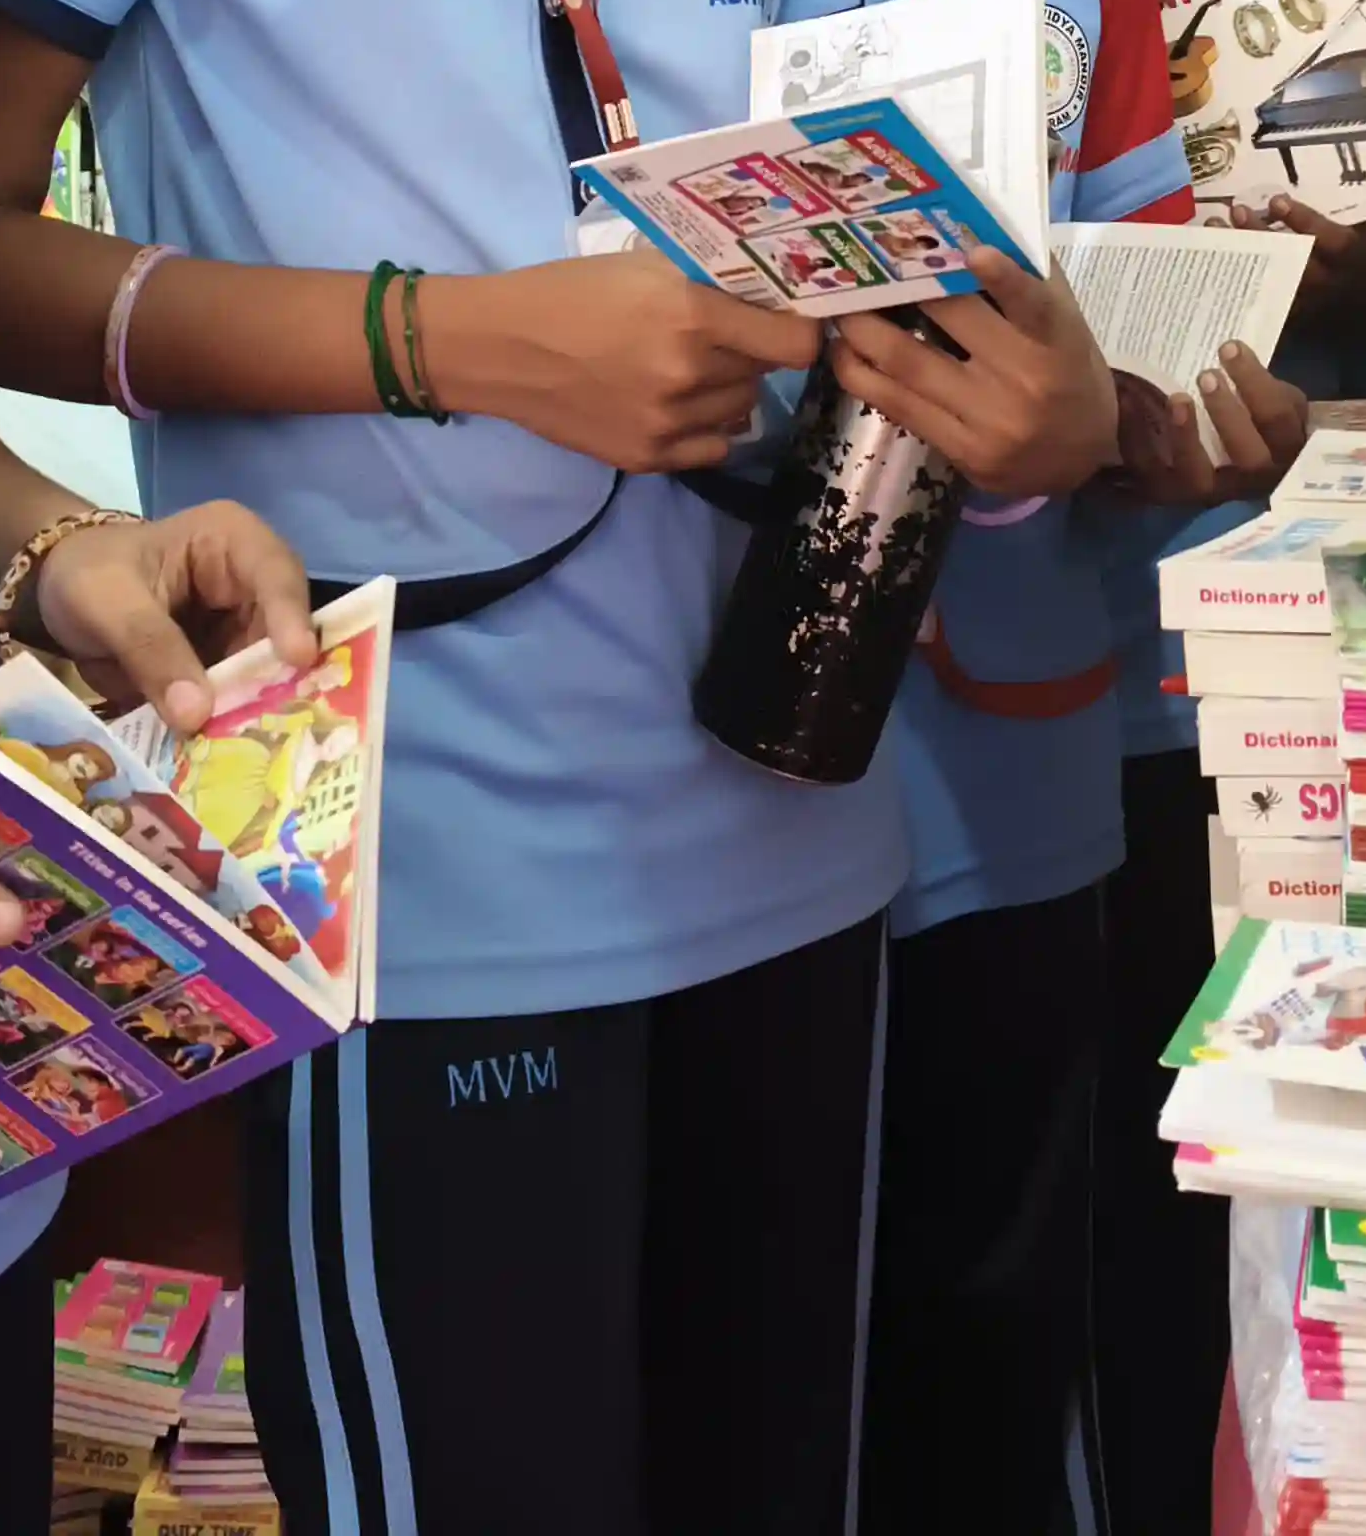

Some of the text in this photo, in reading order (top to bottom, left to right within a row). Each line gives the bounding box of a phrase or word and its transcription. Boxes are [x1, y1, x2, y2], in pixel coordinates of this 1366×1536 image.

[1073, 36, 1089, 103] MANDIR
[1199, 587, 1326, 607] Dictionary of
[68, 839, 115, 881] Titles
[114, 871, 134, 894] in
[133, 888, 161, 913] the
[159, 906, 209, 948] series
[447, 1046, 557, 1107] MVM
